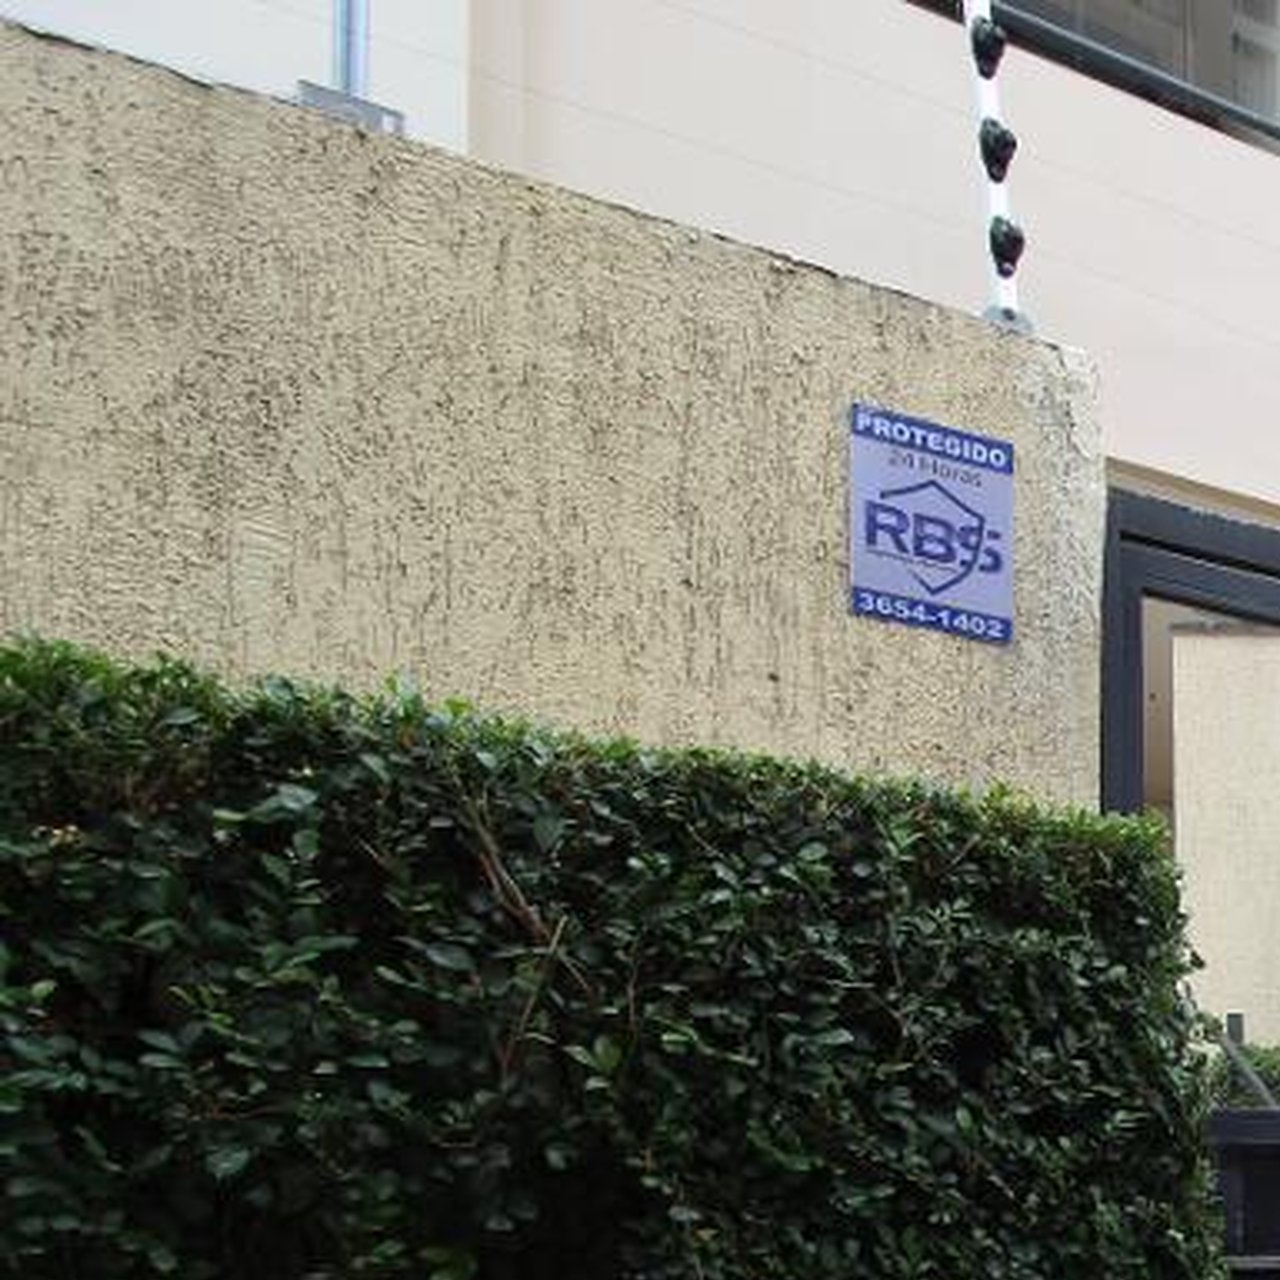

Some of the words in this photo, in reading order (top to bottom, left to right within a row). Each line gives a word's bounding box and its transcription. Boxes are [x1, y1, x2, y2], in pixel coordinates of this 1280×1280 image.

[856, 413, 1006, 467] PROTEGIDO
[865, 500, 1002, 573] RBS
[858, 593, 1004, 638] 3654-1402
